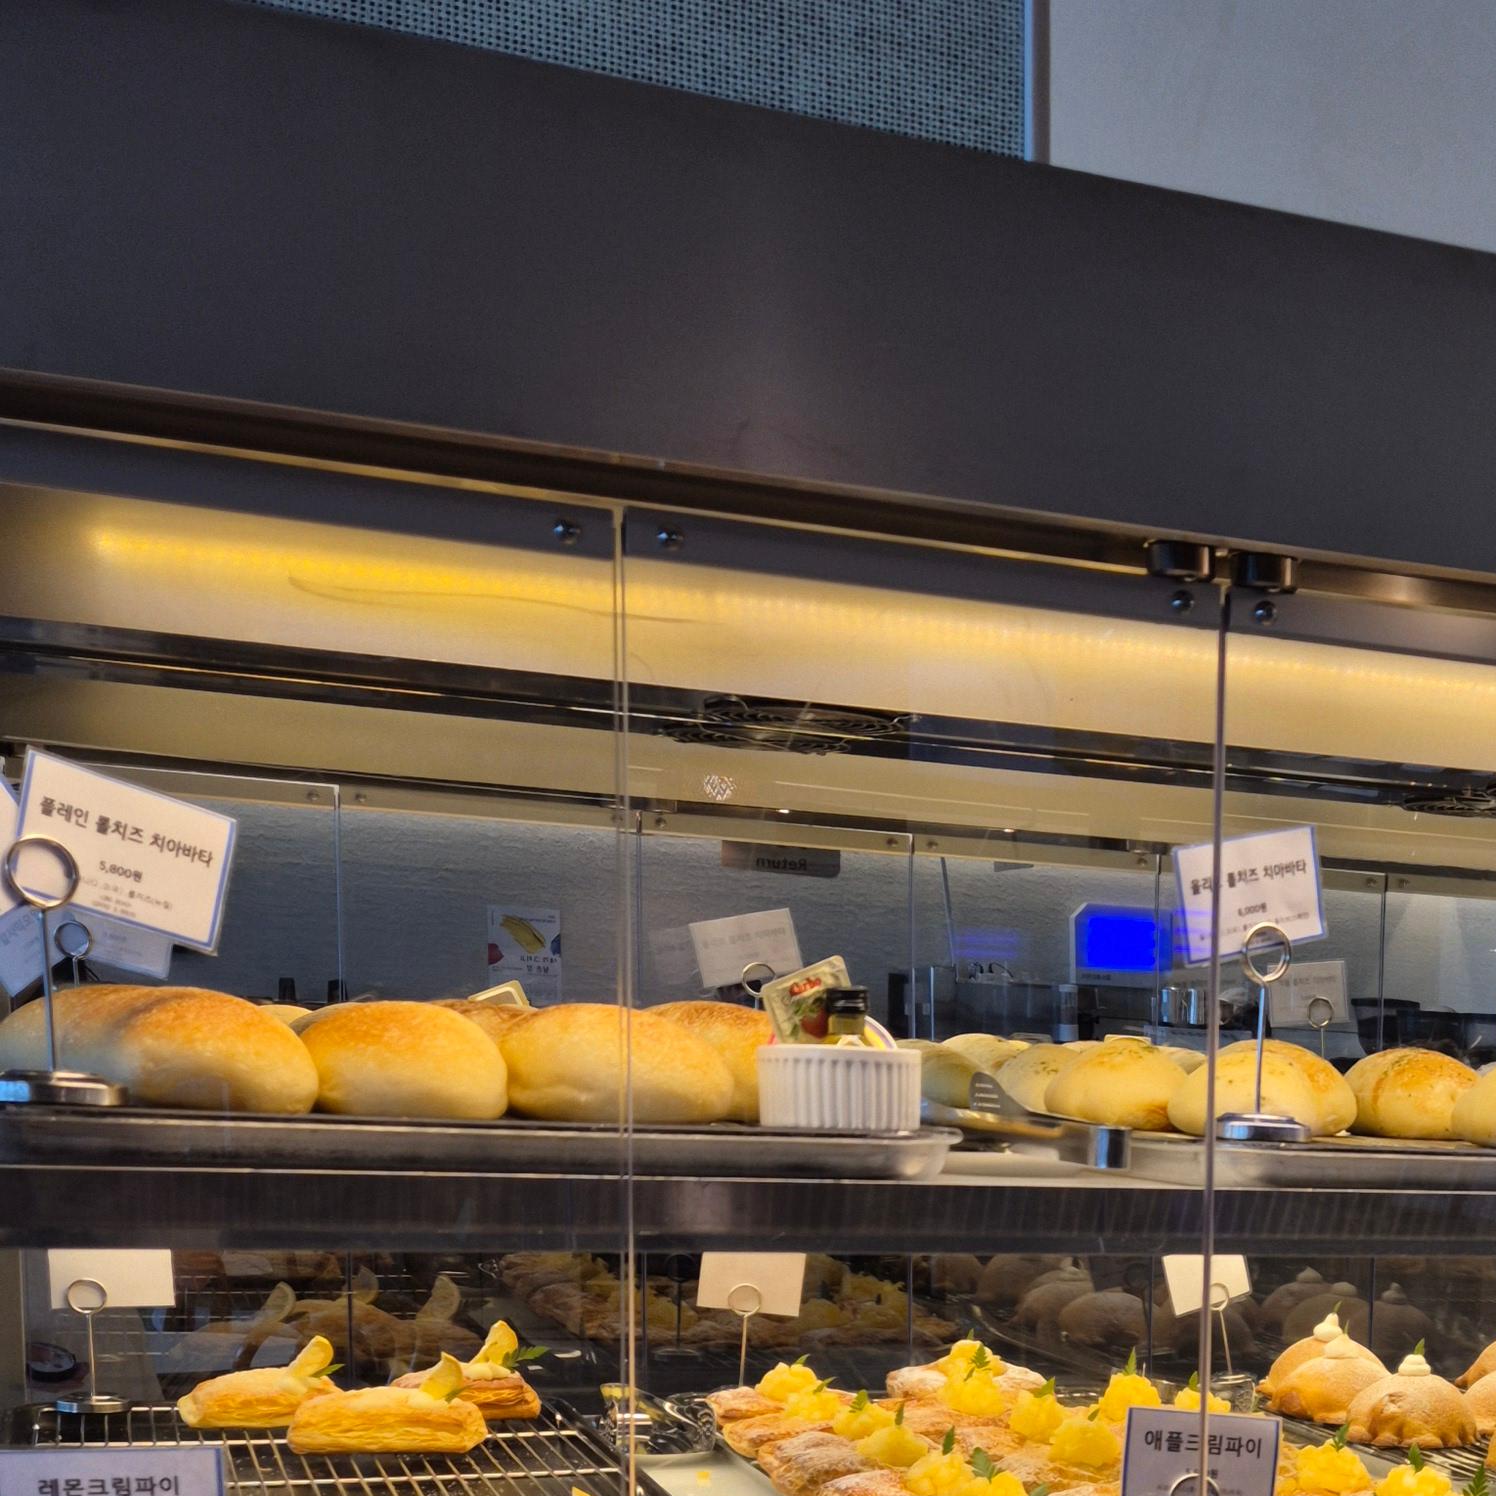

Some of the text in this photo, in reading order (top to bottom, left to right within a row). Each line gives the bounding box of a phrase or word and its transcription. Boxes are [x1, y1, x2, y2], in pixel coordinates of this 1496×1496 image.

[39, 796, 214, 868] 플레인 롤치즈 치아바타
[99, 859, 143, 884] 5,800원
[1190, 874, 1222, 896] 올리
